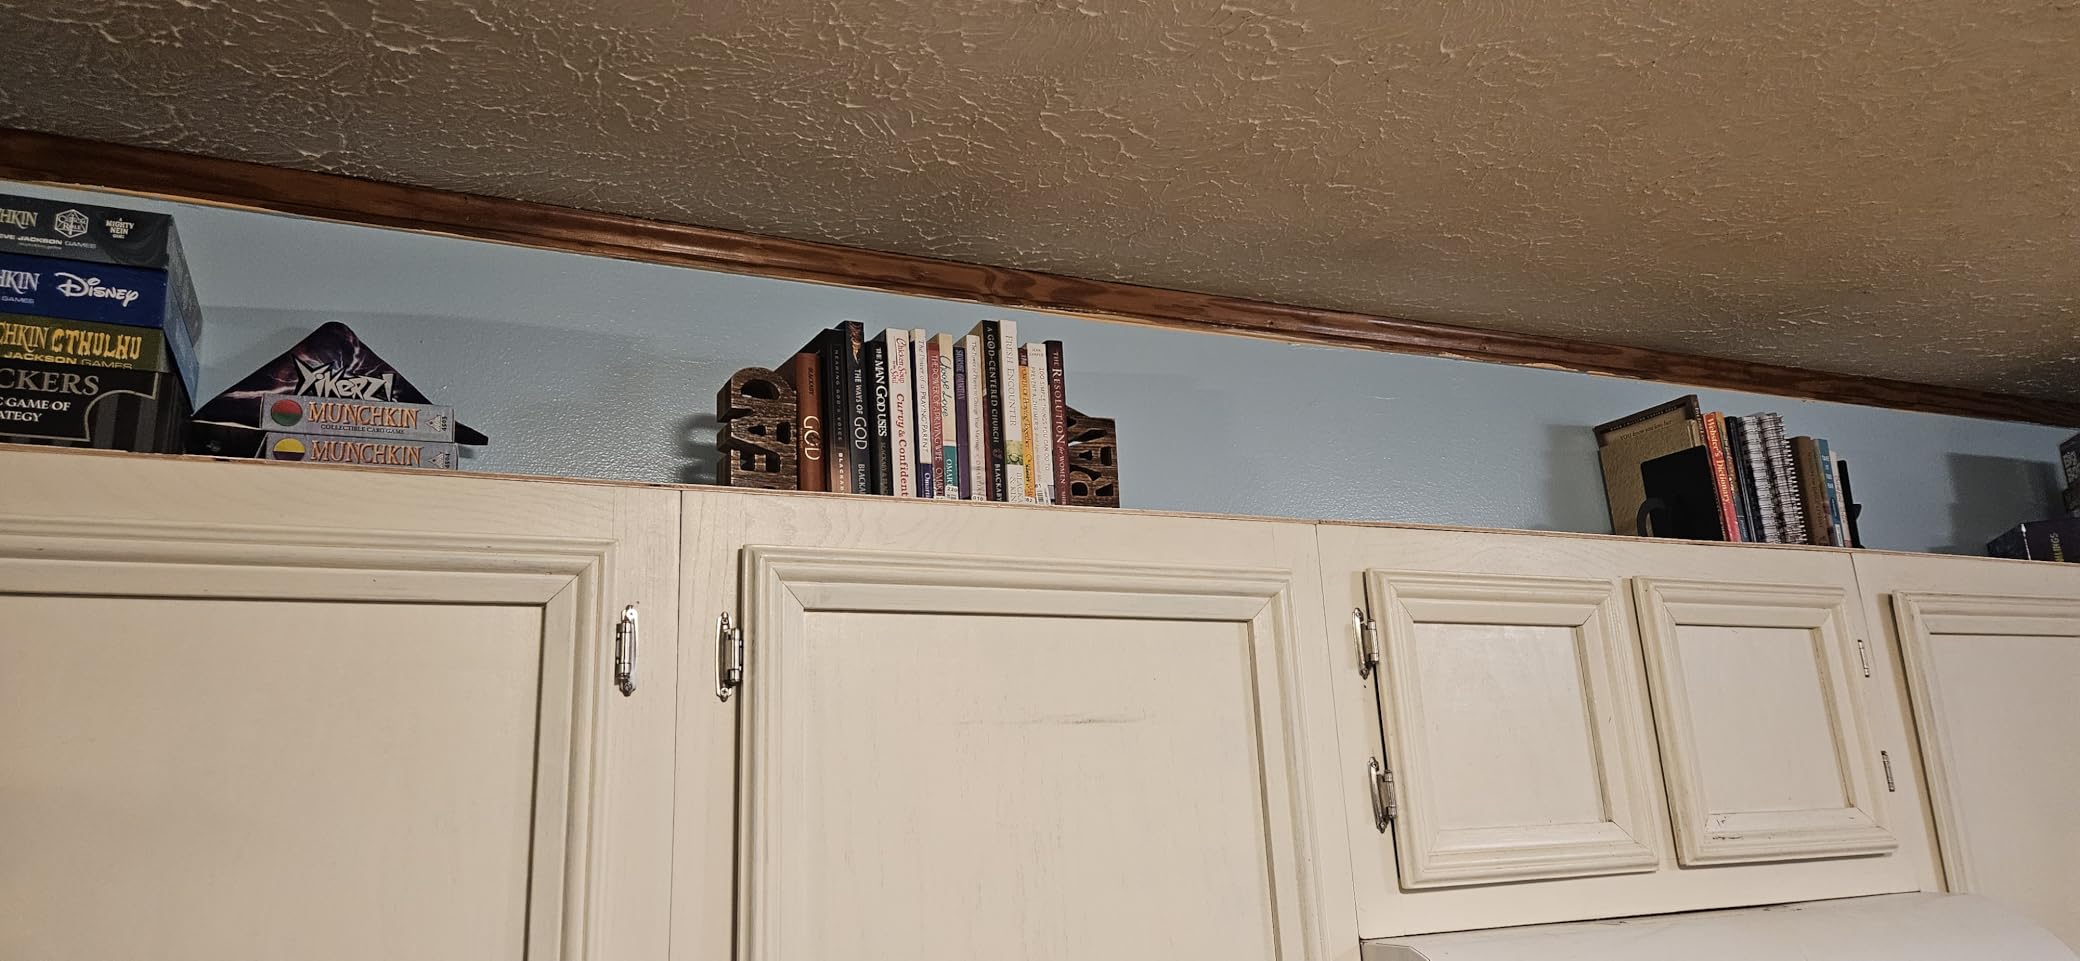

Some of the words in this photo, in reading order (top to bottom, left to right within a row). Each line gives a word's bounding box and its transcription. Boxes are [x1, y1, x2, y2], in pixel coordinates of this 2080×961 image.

[105, 220, 135, 229] MIGHTY
[18, 235, 63, 245] JACKSON
[4, 351, 78, 364] JACKSON
[51, 328, 142, 360] CTHULHU
[1005, 335, 1014, 364] FRESH
[854, 369, 862, 383] THE
[874, 360, 886, 384] MAN
[931, 367, 940, 396] POWER
[940, 355, 952, 390] Choose
[987, 335, 998, 407] GOD-CENTERED
[6, 397, 50, 410] GAME
[51, 400, 72, 411] OF
[855, 384, 863, 403] WAYS
[875, 385, 888, 412] GOD
[942, 391, 952, 417] Love
[1007, 368, 1017, 426] ENCOUNTER
[1051, 368, 1065, 445] RESOLUTION
[308, 401, 421, 429] MUNCHKIN
[856, 404, 864, 415] OF
[896, 393, 904, 428] Curvy
[320, 424, 366, 432] COLLECTIBLE
[731, 367, 797, 490] EAD
[803, 415, 820, 461] GOD
[854, 416, 868, 450] GOD
[877, 414, 887, 437] USES
[921, 423, 929, 453] PARENT
[933, 411, 942, 444] PRAYING
[991, 409, 999, 443] CHURCH
[310, 440, 424, 468] MUNCHKIN
[899, 439, 908, 497] Confident
[1707, 418, 1722, 458] Webster's
[1716, 460, 1730, 503] Dictionary
